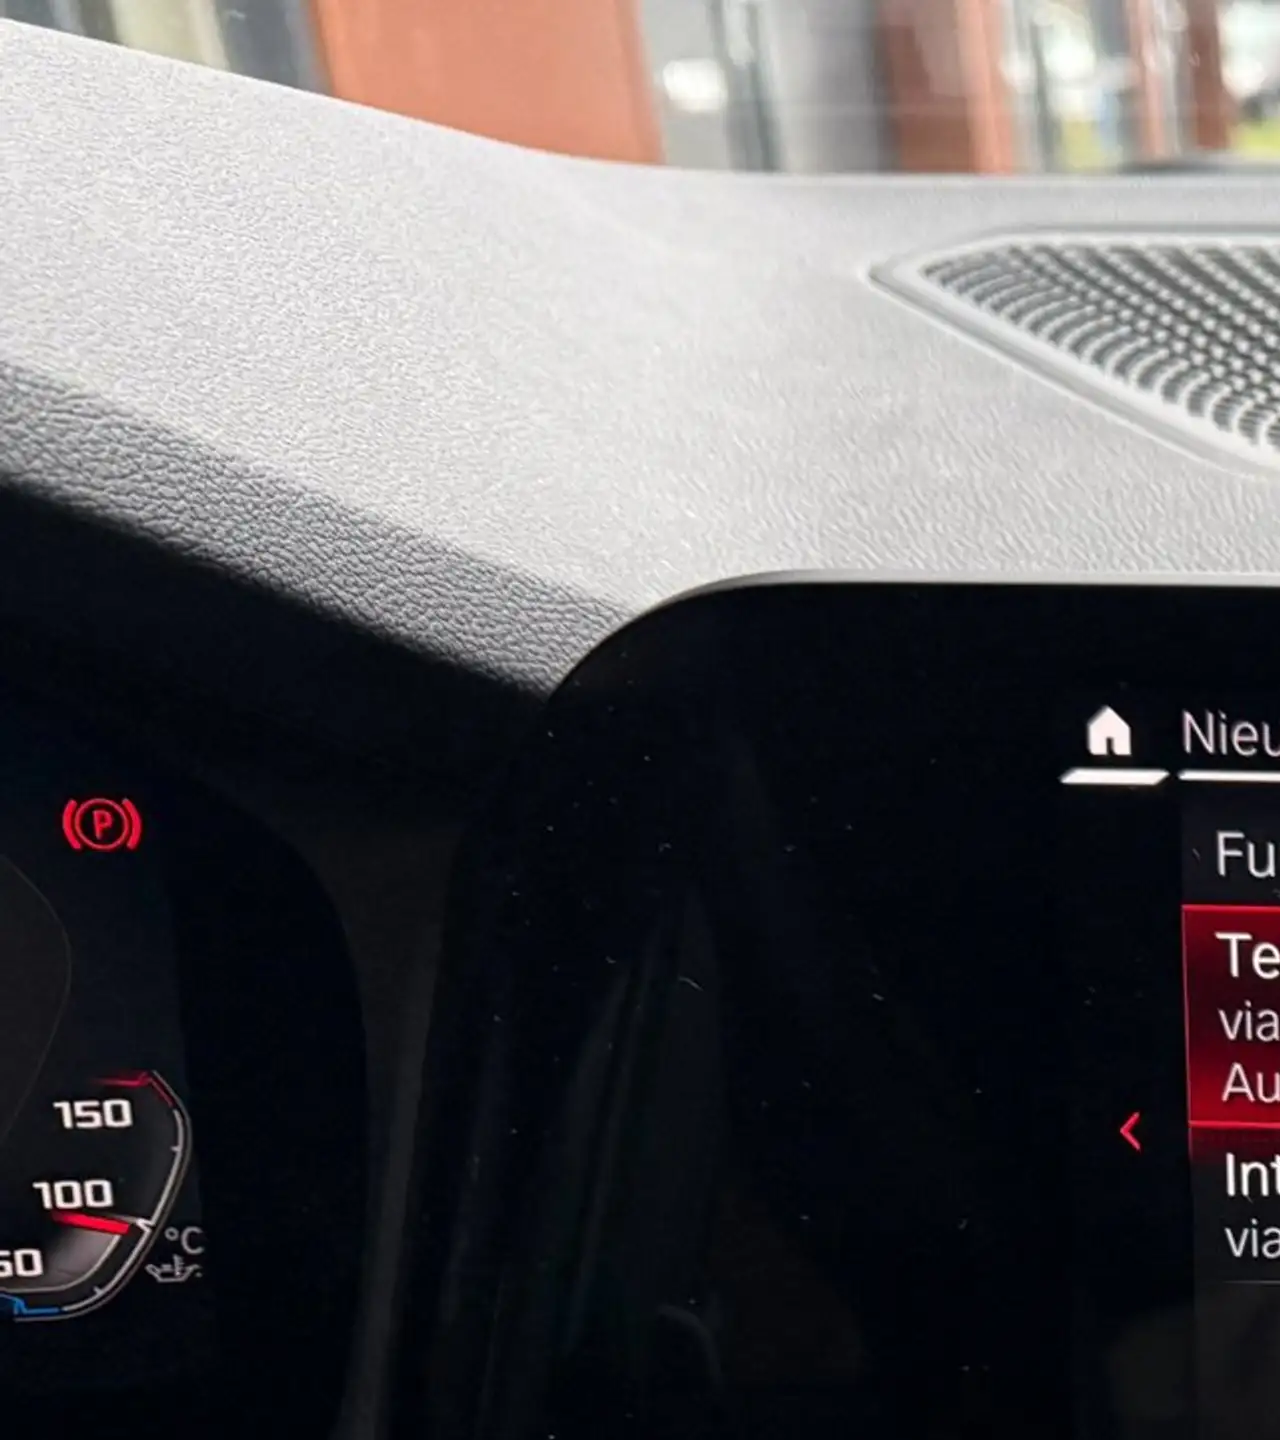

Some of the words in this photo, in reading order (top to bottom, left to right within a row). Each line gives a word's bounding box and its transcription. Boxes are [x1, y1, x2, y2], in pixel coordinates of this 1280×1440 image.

[93, 809, 113, 839] P
[1218, 1000, 1280, 1042] via
[53, 1099, 132, 1129] 150
[32, 1179, 113, 1209] 100
